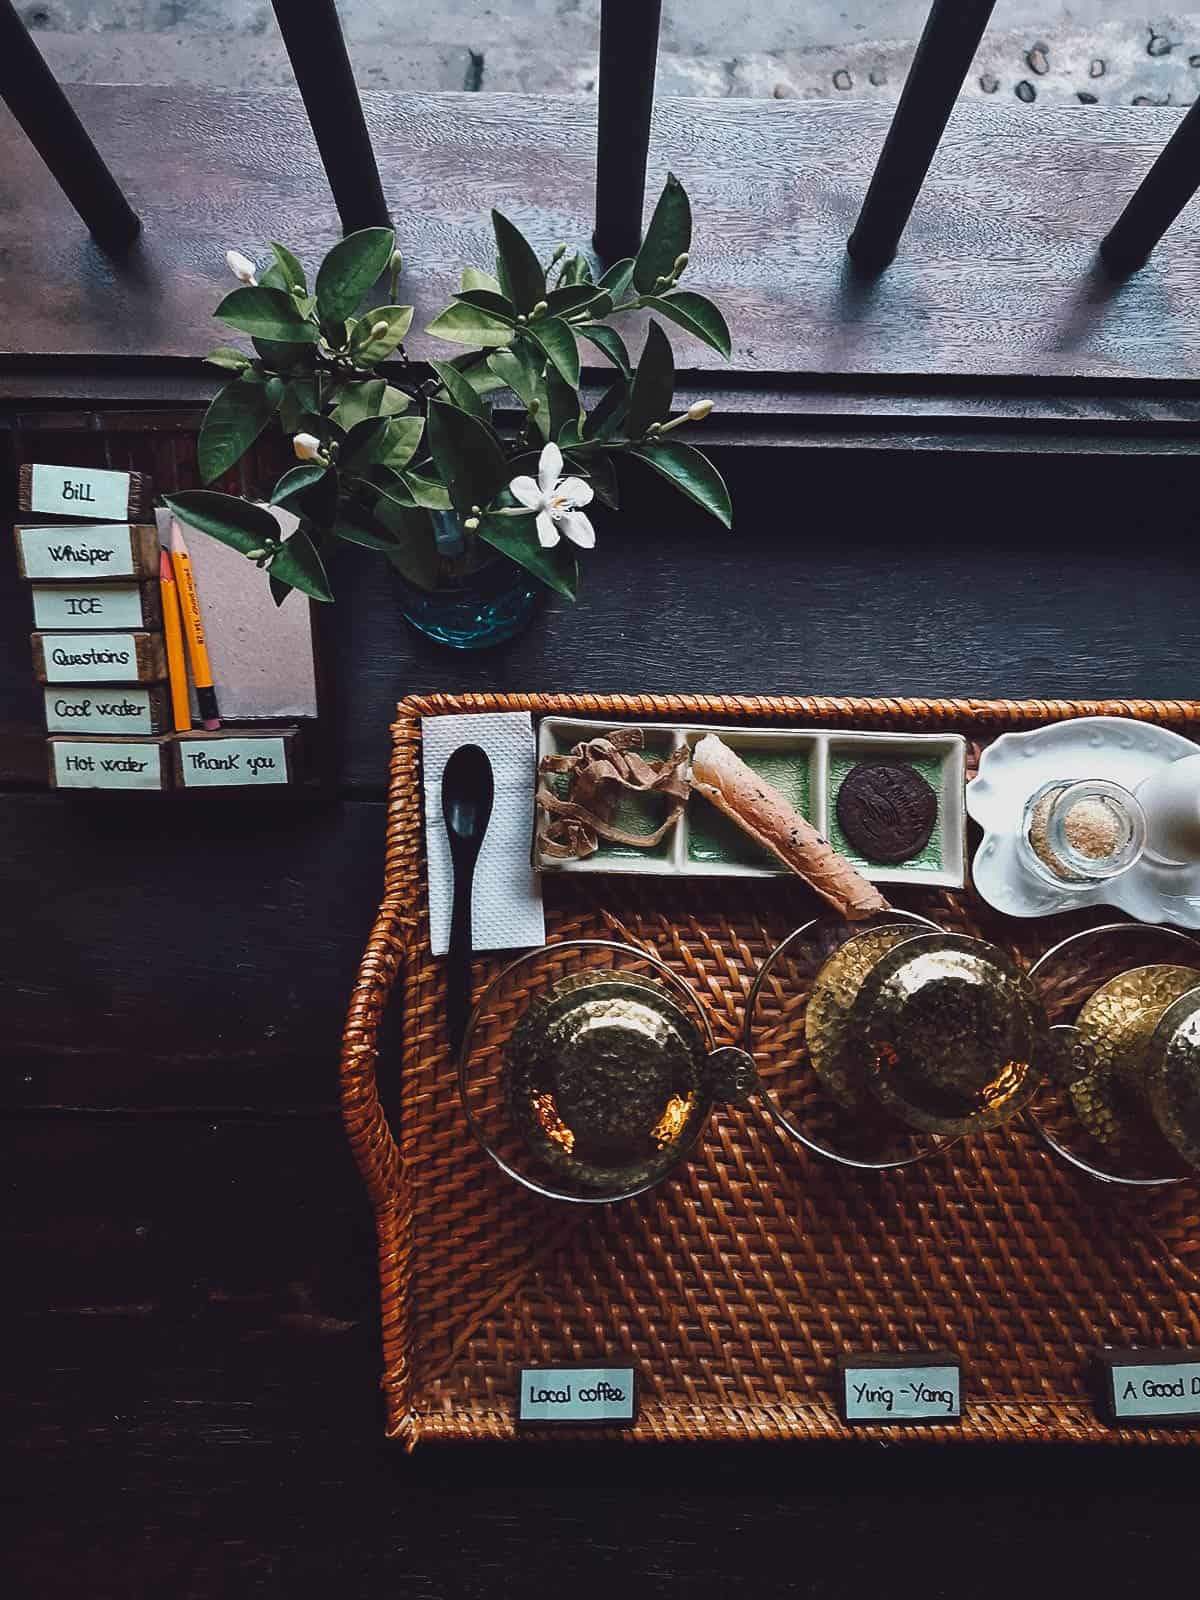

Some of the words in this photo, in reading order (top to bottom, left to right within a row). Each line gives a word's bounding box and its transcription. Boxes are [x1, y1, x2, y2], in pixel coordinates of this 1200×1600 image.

[47, 543, 115, 566] Whisper
[64, 598, 103, 616] ICE
[52, 648, 130, 666] Questions
[54, 699, 92, 717] Cool
[95, 698, 147, 717] water
[65, 756, 96, 772] Hot
[100, 756, 149, 773] water
[246, 755, 276, 776] you
[529, 1384, 572, 1404] Local
[578, 1381, 627, 1403] coffee
[852, 1382, 894, 1412] Ying
[1122, 1380, 1138, 1399] A
[1142, 1377, 1185, 1398] Good
